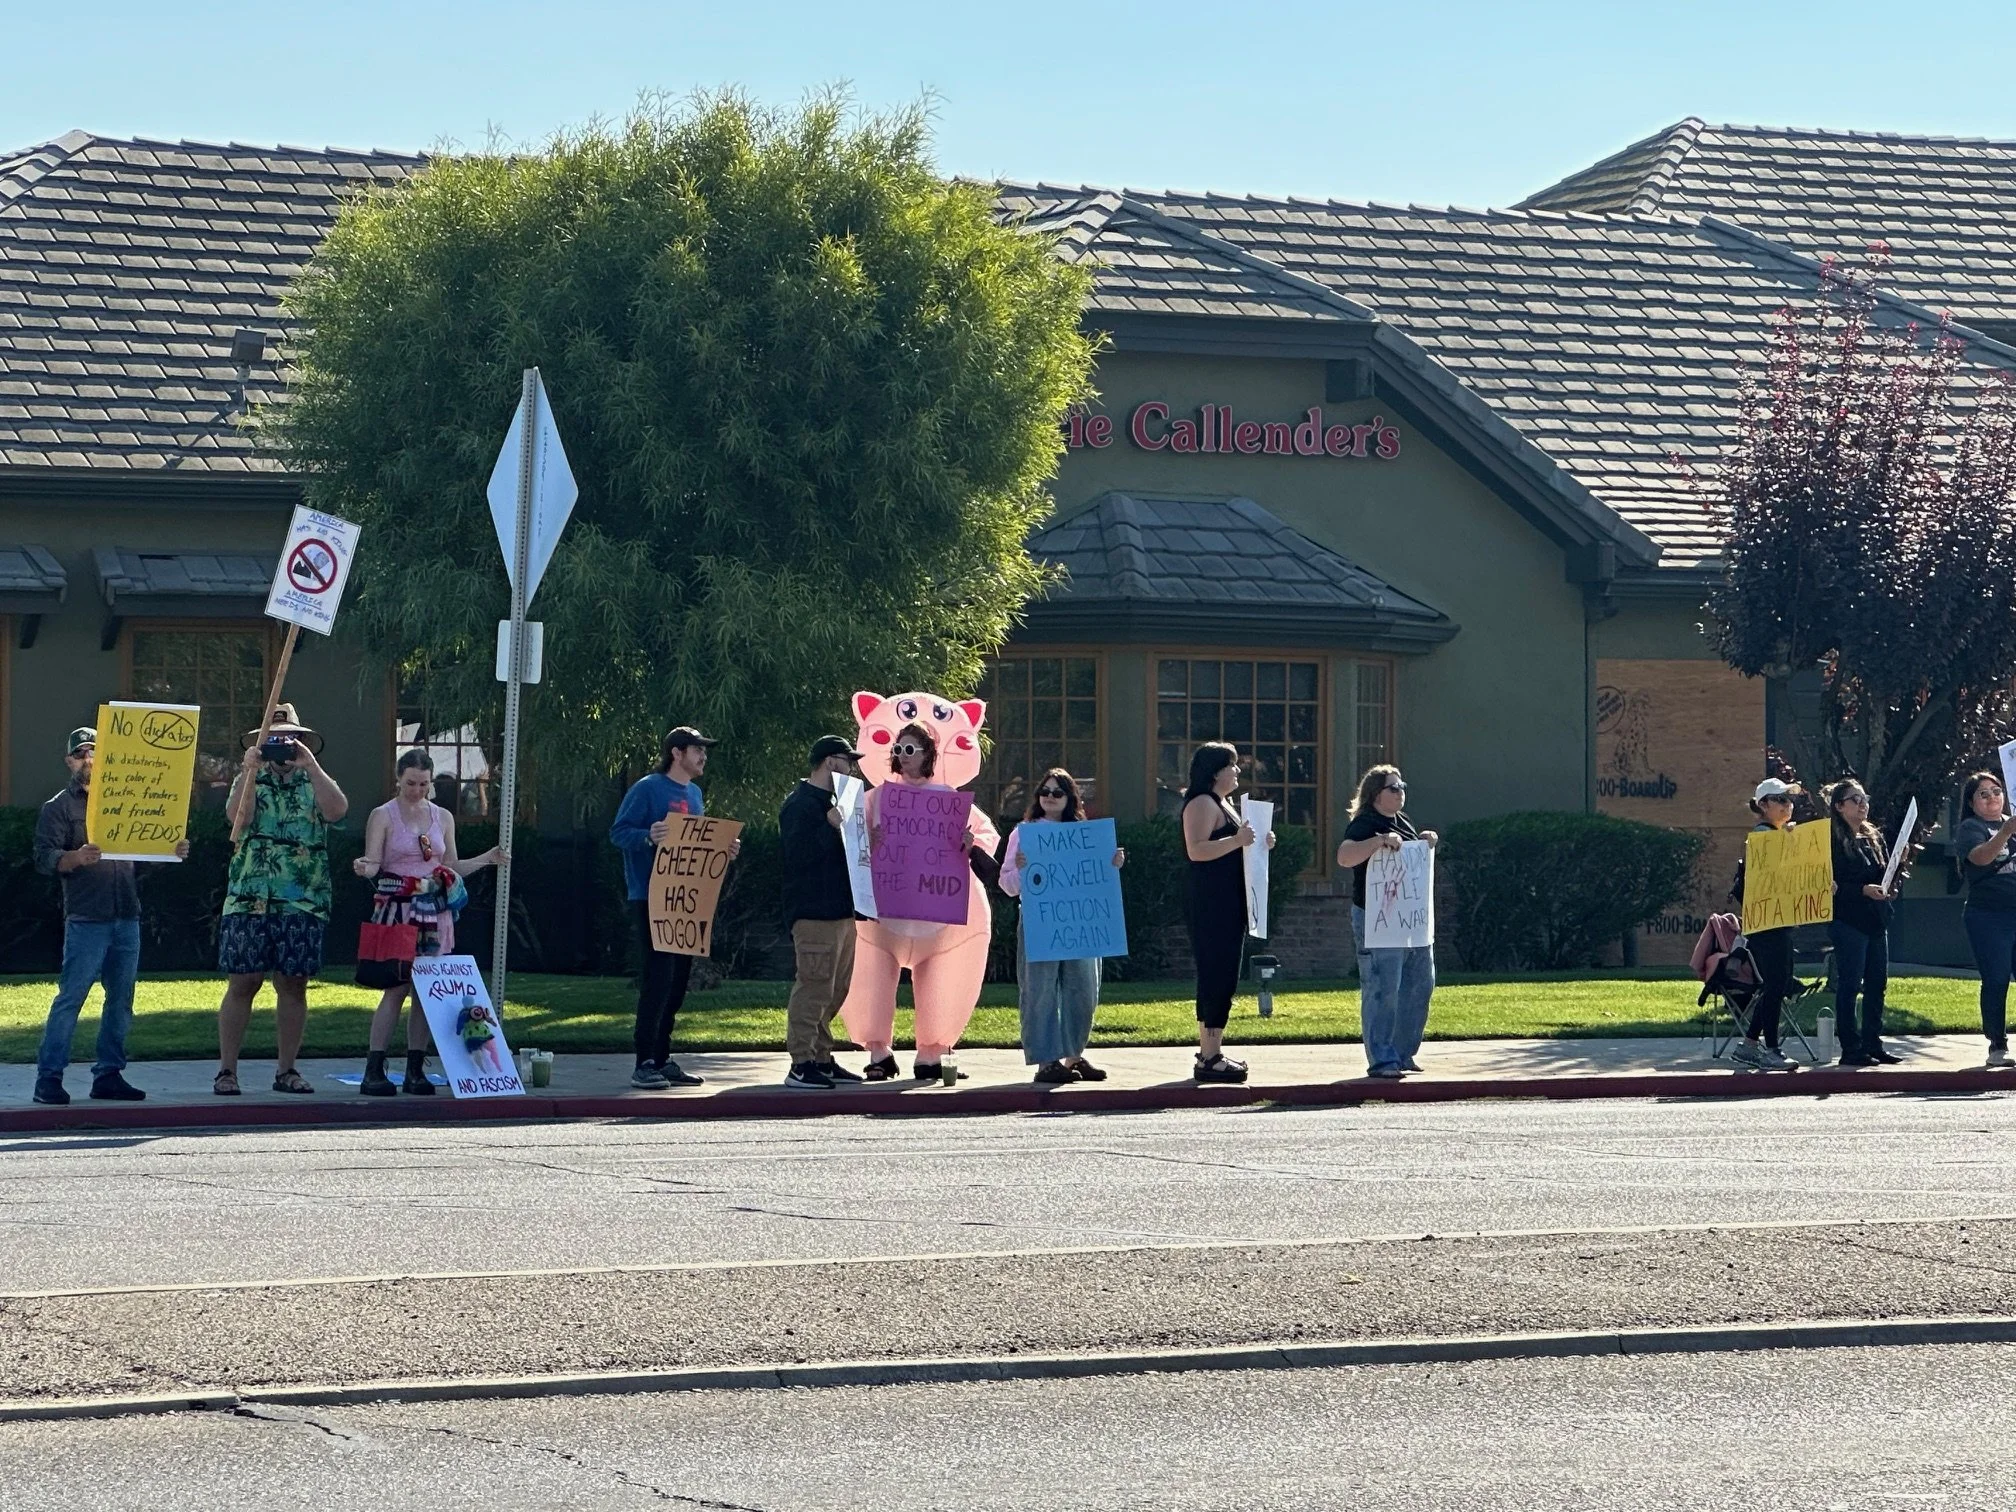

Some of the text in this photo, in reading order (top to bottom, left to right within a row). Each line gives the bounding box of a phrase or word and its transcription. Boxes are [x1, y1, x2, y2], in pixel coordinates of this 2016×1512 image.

[1132, 401, 1401, 460] Callender's
[309, 512, 345, 529] AMERICA
[286, 590, 323, 606] AMERICA
[110, 710, 134, 737] No
[105, 754, 116, 765] No
[101, 772, 164, 785] the color of
[143, 788, 179, 802] funders
[887, 788, 962, 816] GET OUR
[102, 802, 166, 818] and friends
[106, 820, 183, 843] of PEDOS
[680, 817, 719, 842] THE
[881, 813, 965, 841] DEMOCRACY
[1037, 827, 1096, 854] MAKE
[1808, 828, 1821, 854] A
[656, 846, 728, 880] CHEETO
[878, 843, 949, 866] OUT OF
[875, 872, 962, 897] THE MUD
[1026, 859, 1109, 896] ORWELL
[1370, 877, 1421, 901] TALE
[665, 884, 699, 914] HAS
[1038, 897, 1111, 923] FICTION
[1743, 889, 1831, 931] NOT A KING
[1374, 909, 1388, 932] A
[1050, 925, 1111, 950] AGAIN
[412, 962, 473, 977] NANAS AGAINST
[457, 1075, 522, 1094] AND FASCISM
